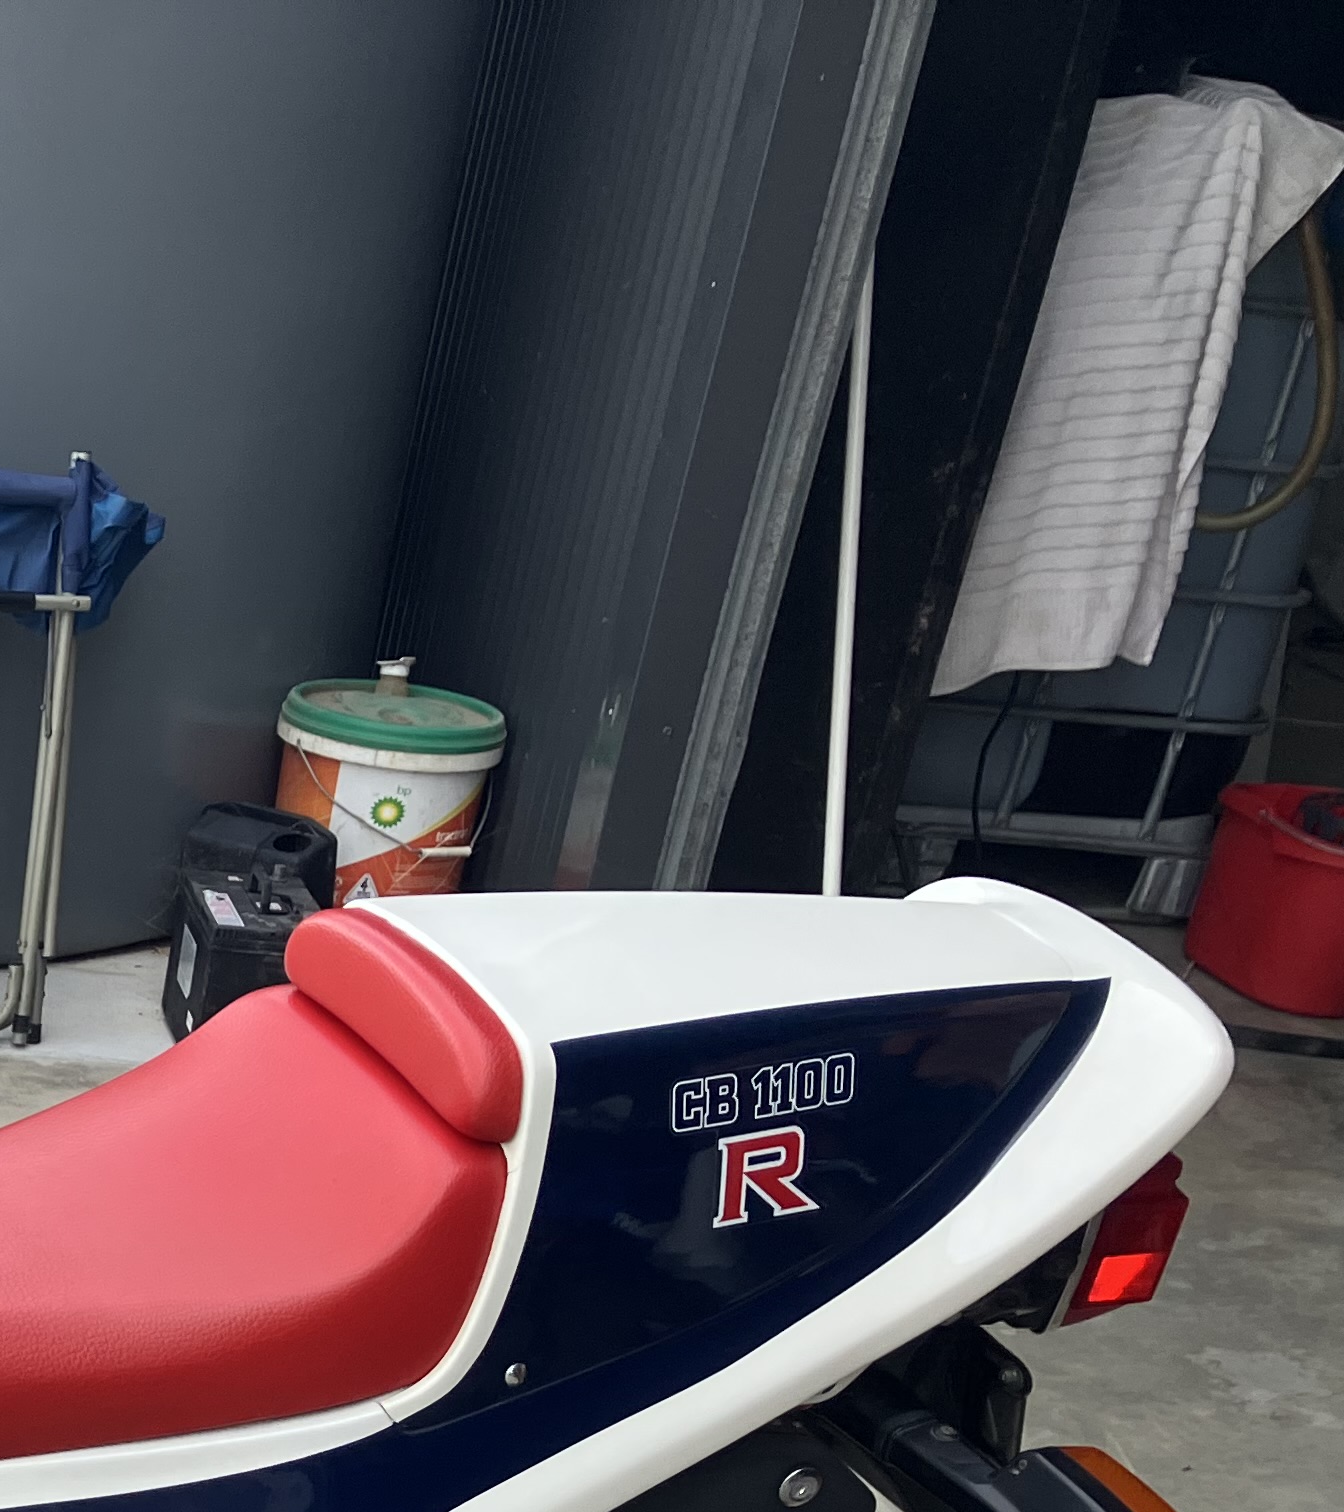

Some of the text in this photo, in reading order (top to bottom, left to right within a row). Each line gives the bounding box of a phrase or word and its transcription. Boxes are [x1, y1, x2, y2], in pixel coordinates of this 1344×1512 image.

[396, 784, 412, 797] bp
[672, 1052, 855, 1133] CB 1100
[712, 1124, 820, 1229] R
